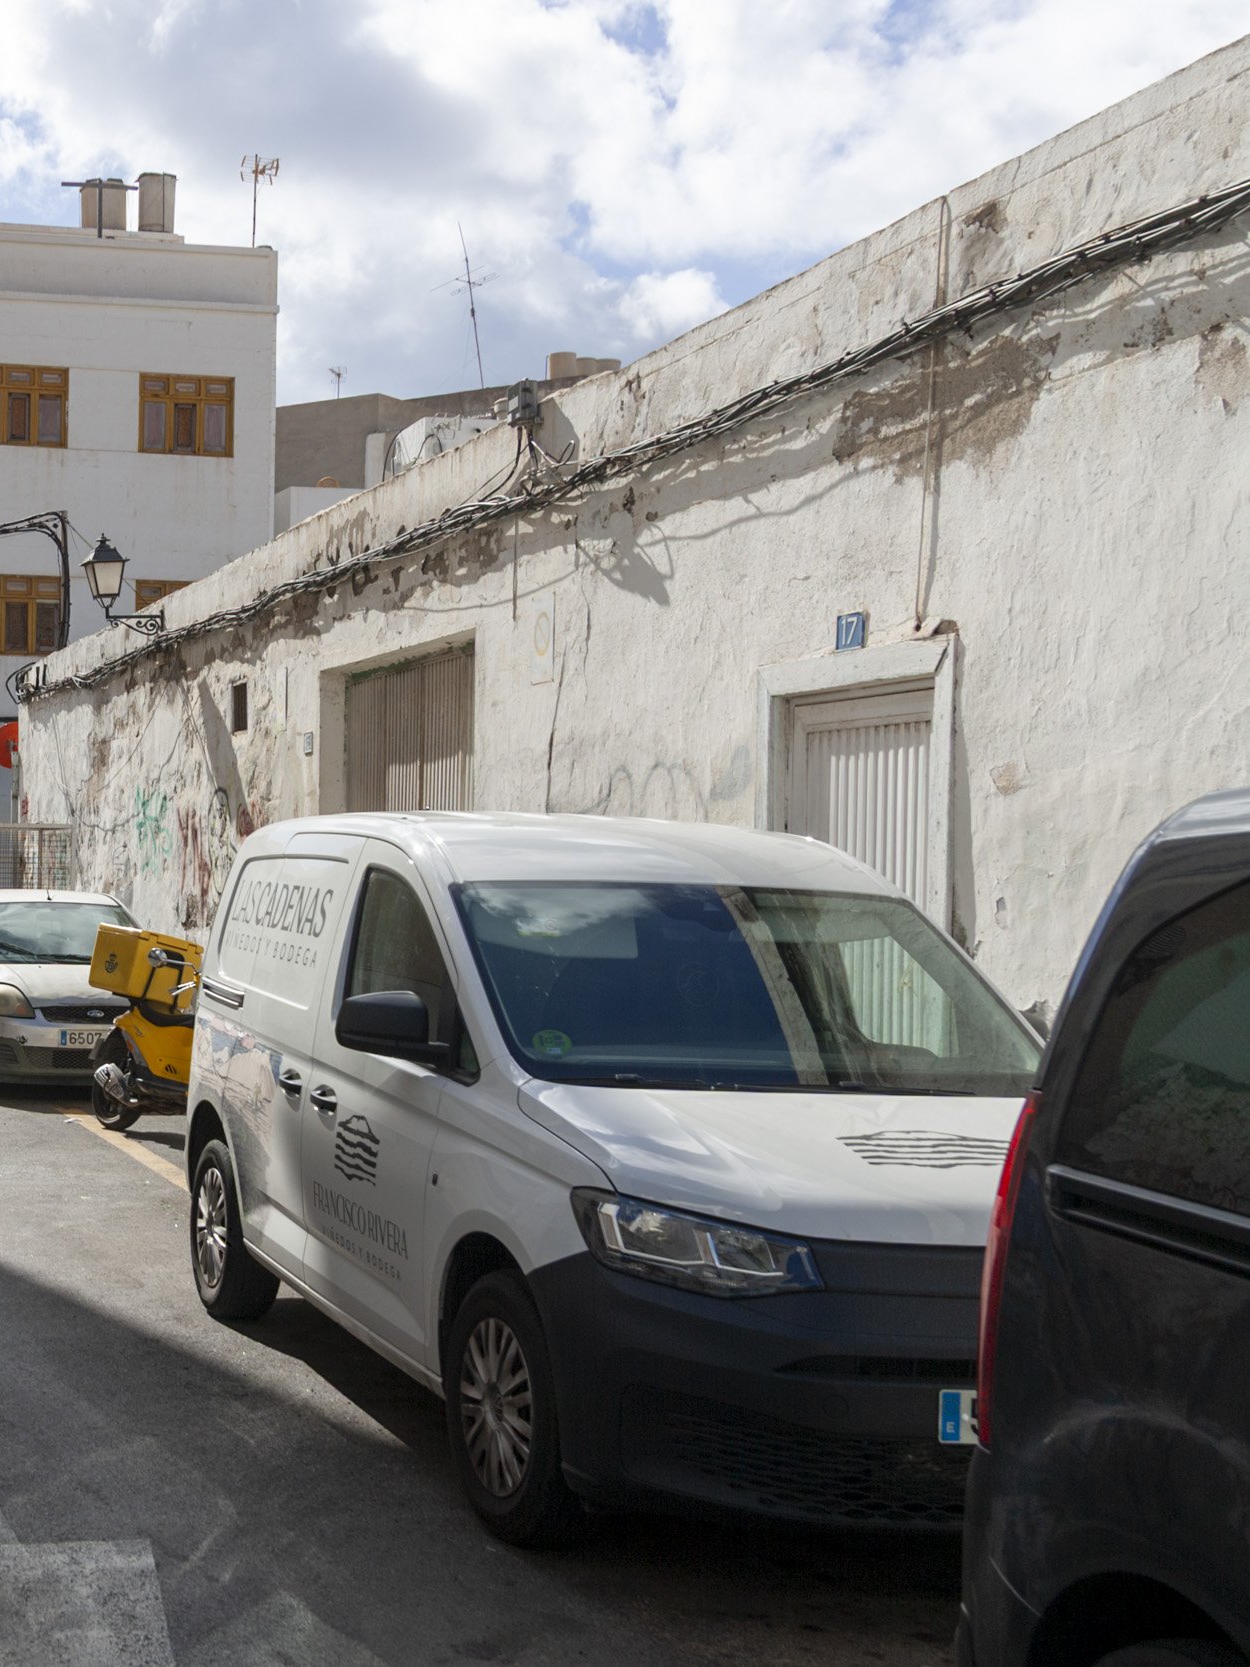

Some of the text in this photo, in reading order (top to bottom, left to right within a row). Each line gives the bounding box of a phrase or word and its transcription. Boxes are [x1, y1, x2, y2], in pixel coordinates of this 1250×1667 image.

[841, 616, 858, 646] 17
[231, 879, 334, 938] LAS CADENAS
[272, 940, 317, 968] BODEGA
[313, 1181, 409, 1260] FRANCISCO RIVERA
[366, 1250, 402, 1281] BODEGA
[945, 1421, 956, 1434] E
